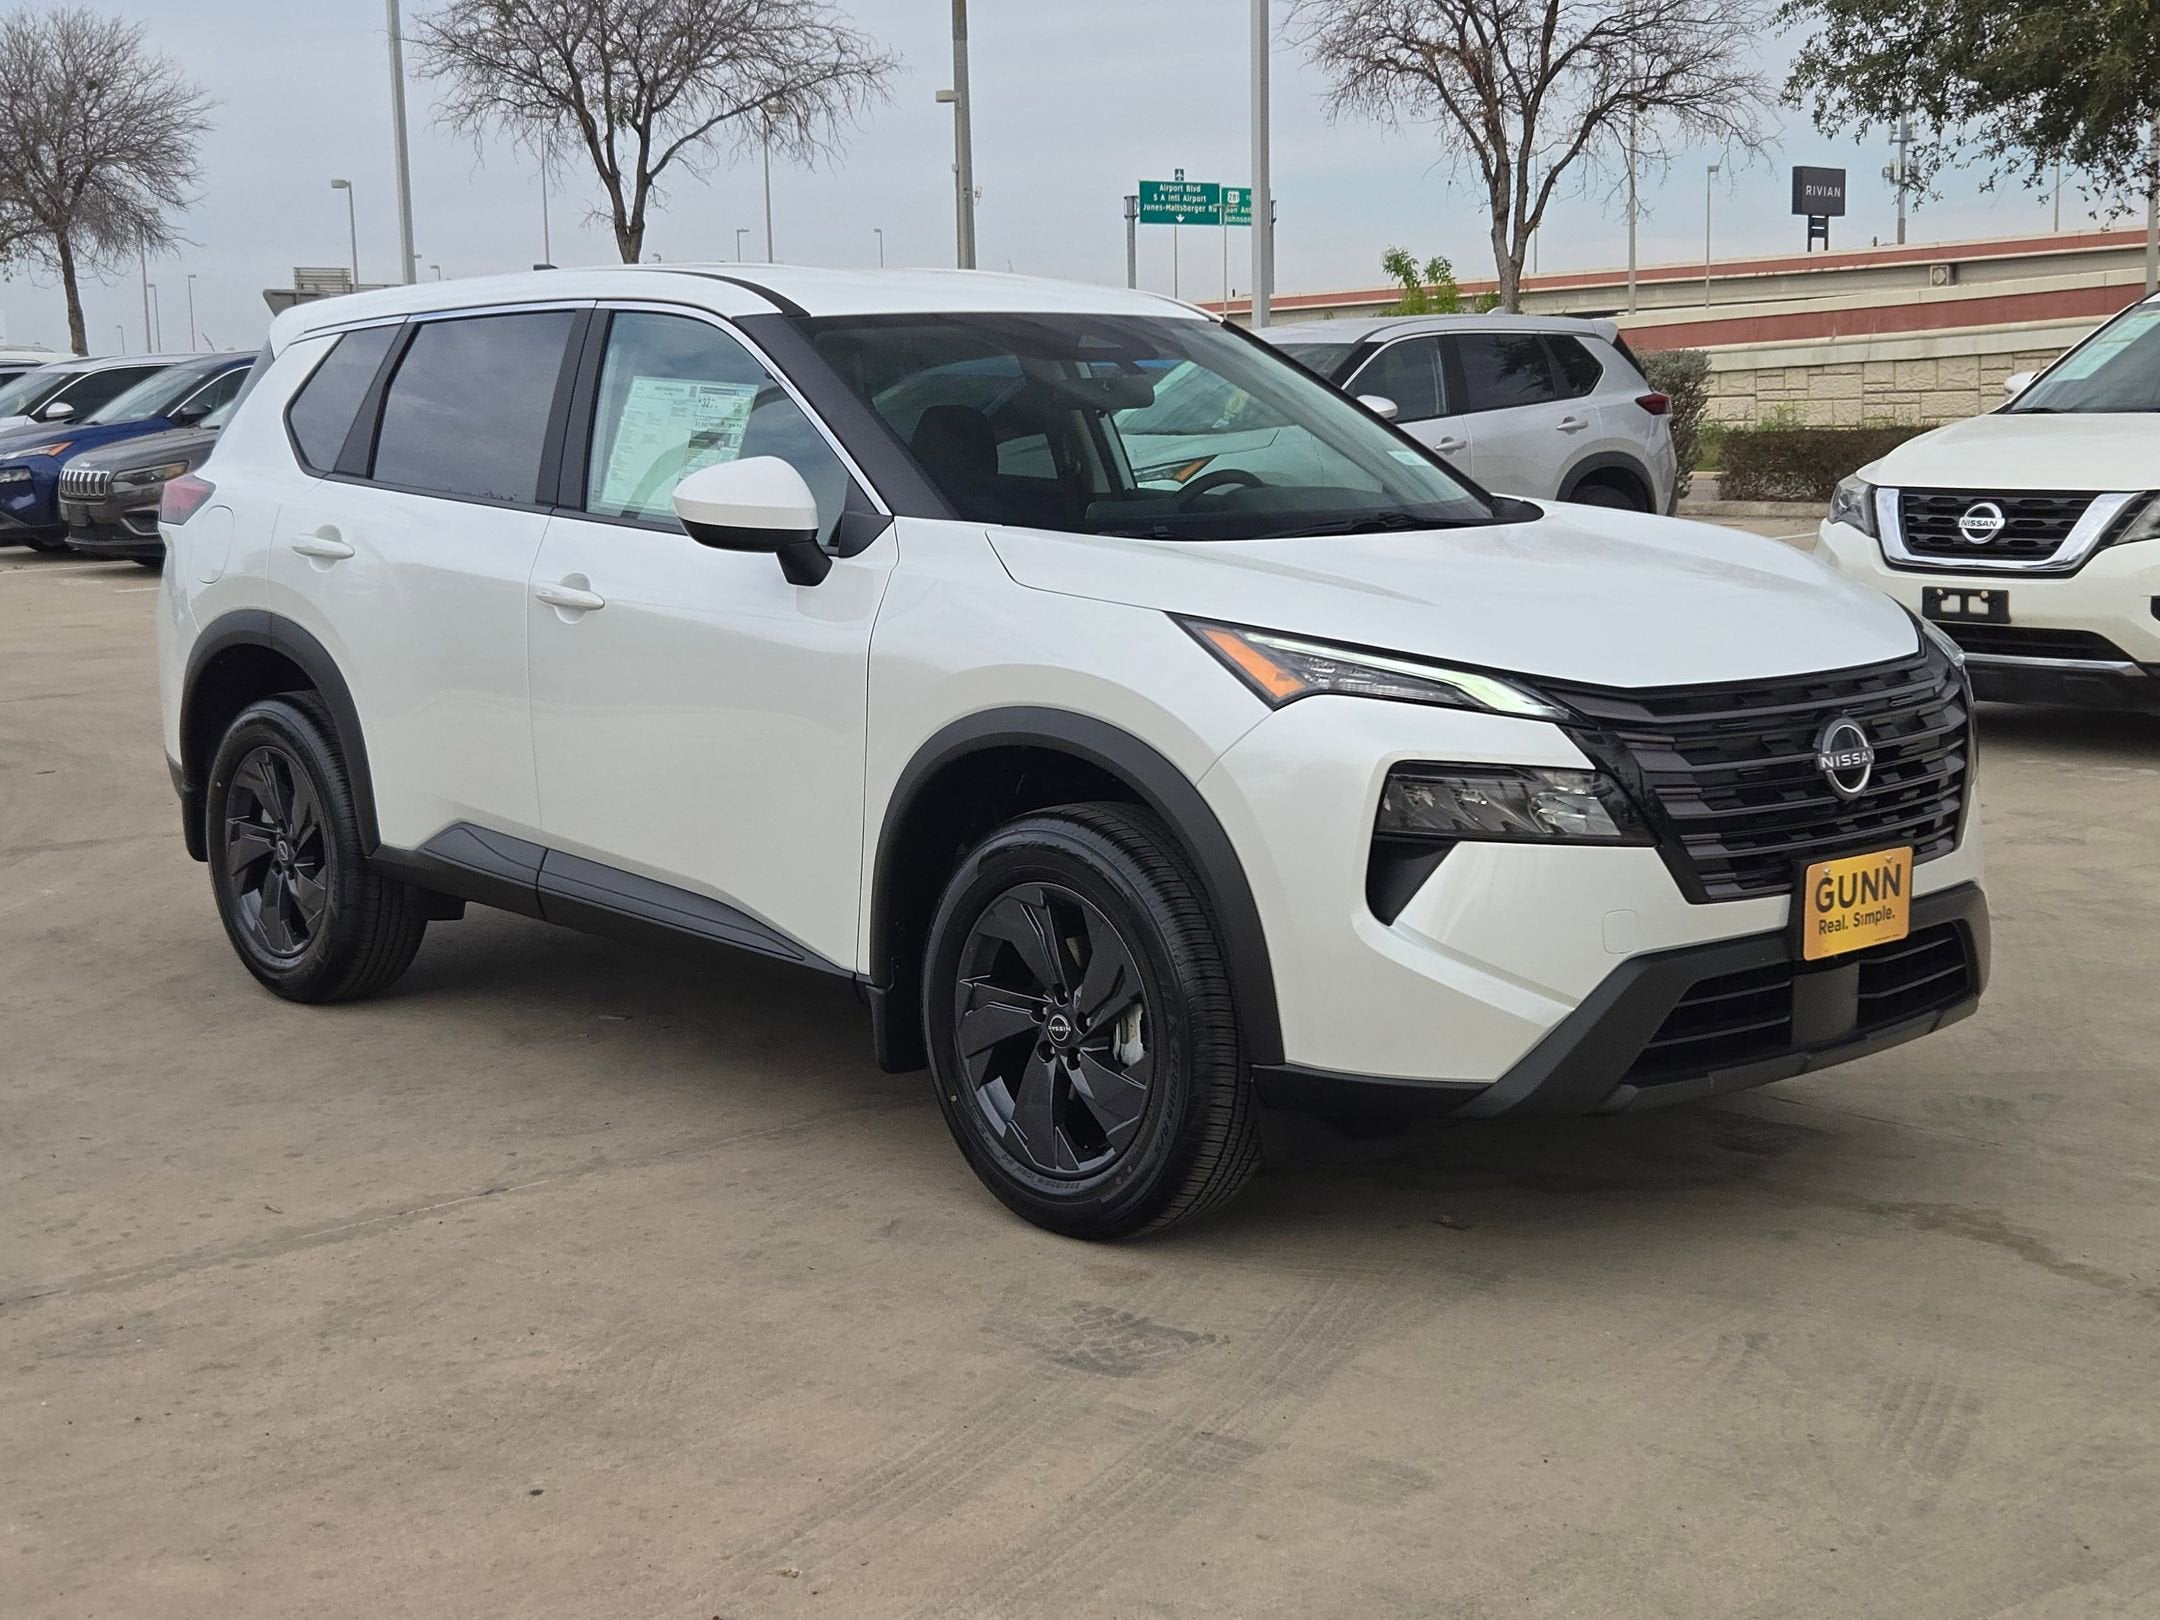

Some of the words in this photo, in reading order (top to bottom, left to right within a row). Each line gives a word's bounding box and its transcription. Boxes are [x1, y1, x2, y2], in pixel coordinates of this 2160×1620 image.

[1159, 183, 1183, 192] Airport
[1186, 184, 1201, 193] Blvd
[1805, 184, 1841, 198] RIVIAN
[1153, 193, 1158, 201] S
[1160, 194, 1165, 202] A
[1182, 194, 1207, 203] Airport
[1961, 519, 1998, 527] NISSAN
[1815, 863, 1902, 914] GUNN
[1818, 914, 1849, 936] Real.
[1852, 905, 1896, 928] Simple.
